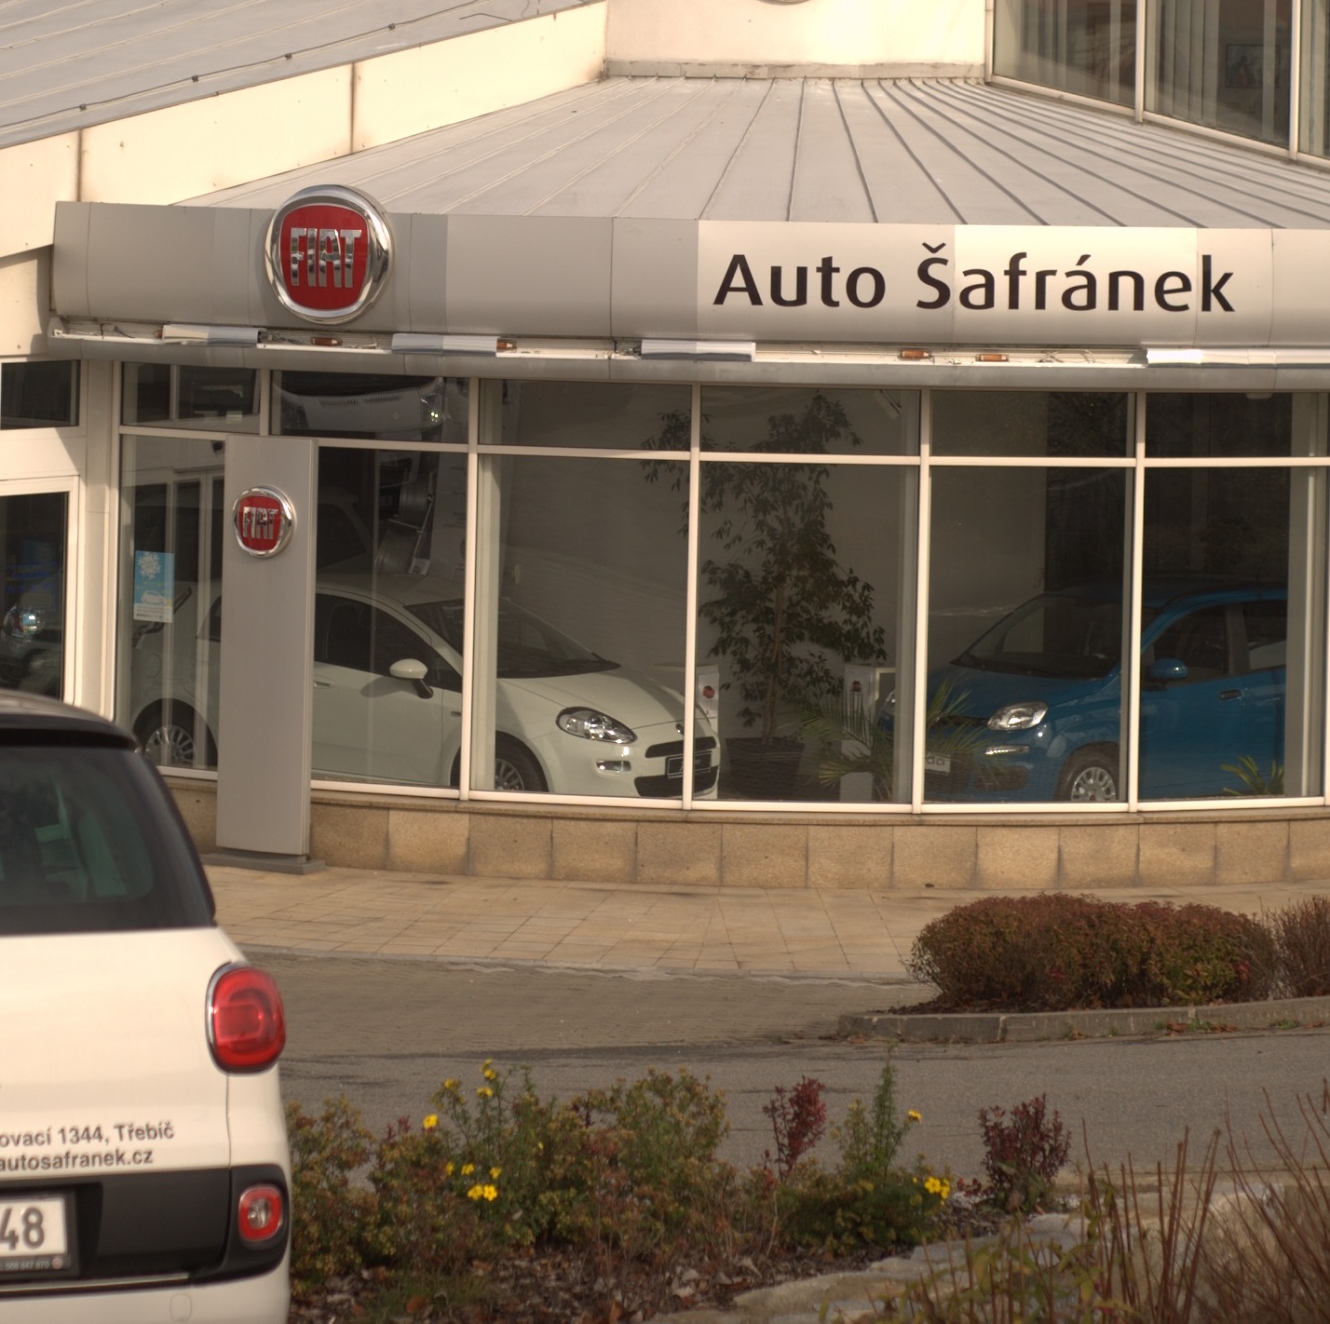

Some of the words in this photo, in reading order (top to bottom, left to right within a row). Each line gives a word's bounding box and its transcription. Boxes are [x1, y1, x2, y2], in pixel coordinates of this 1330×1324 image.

[290, 227, 363, 289] FIAT
[712, 253, 887, 309] Auto
[915, 241, 1236, 313] Šafránek
[243, 506, 279, 540] FIAT
[58, 1125, 110, 1146] 1344,
[113, 1121, 176, 1143] Třebíč
